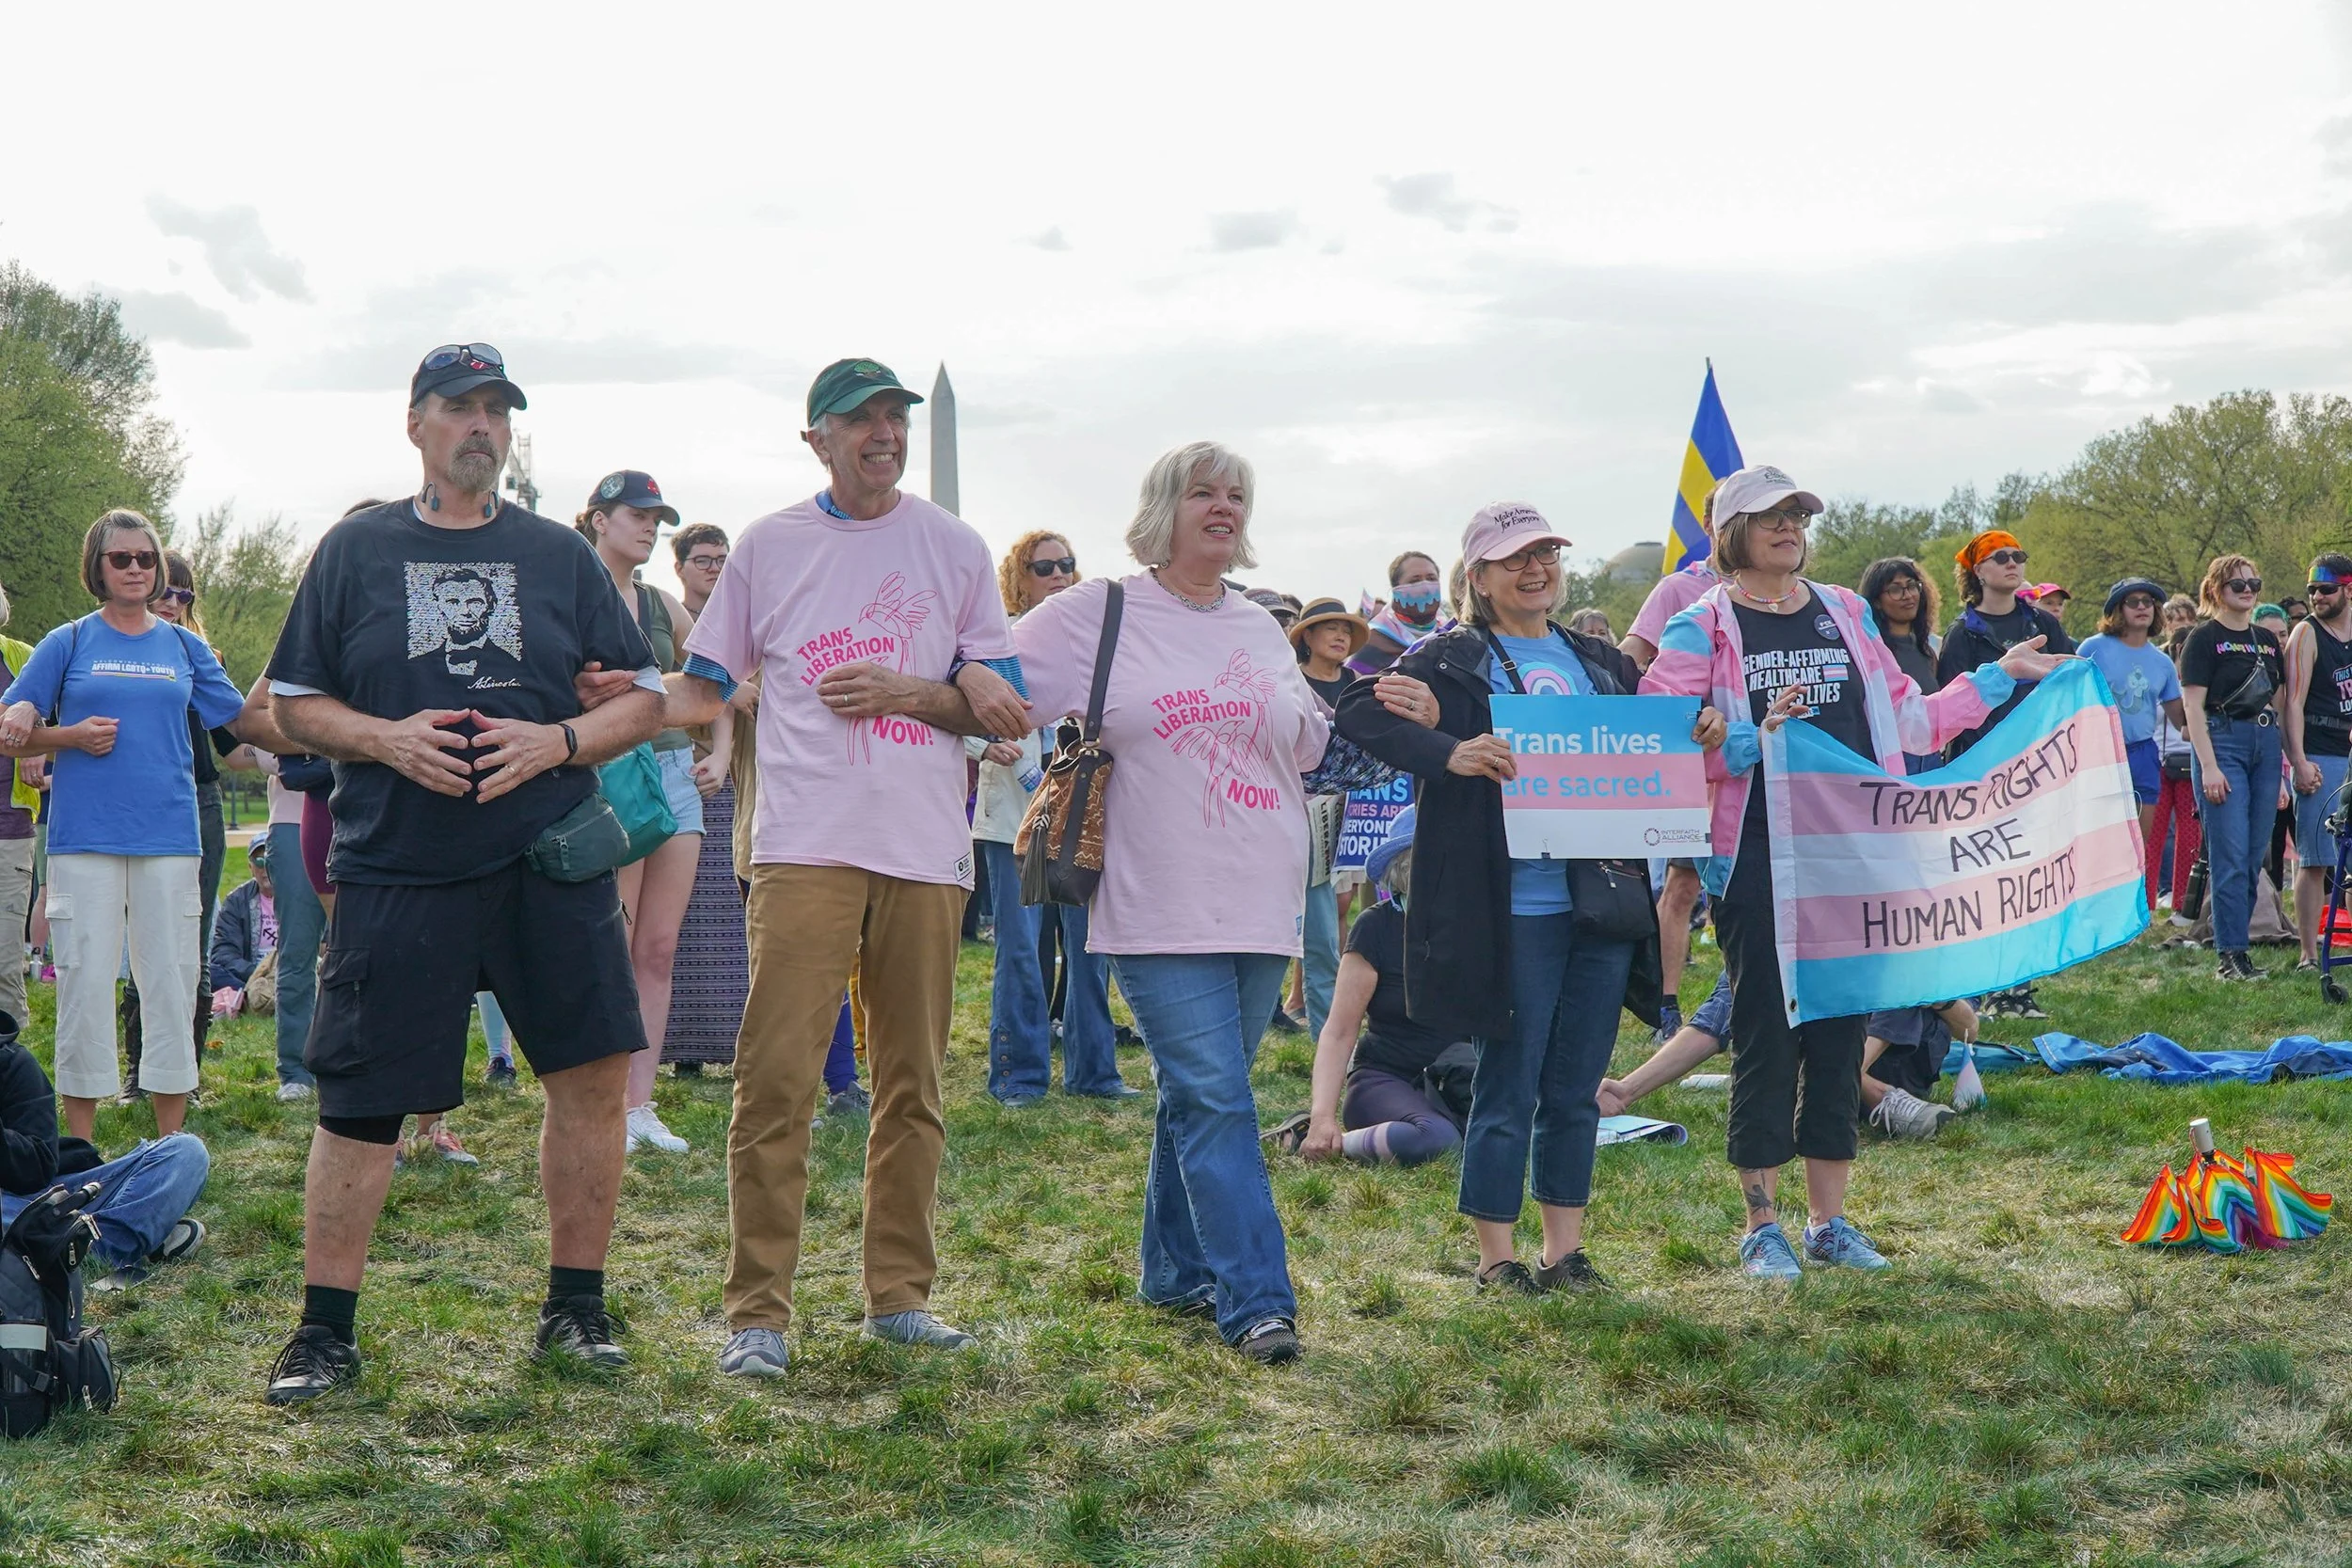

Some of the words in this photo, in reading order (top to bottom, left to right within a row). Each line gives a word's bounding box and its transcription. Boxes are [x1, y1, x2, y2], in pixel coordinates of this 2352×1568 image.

[1494, 511, 1514, 525] Make
[1501, 520, 1511, 533] for
[797, 626, 853, 660] TRANS
[91, 662, 120, 671] AFFIRM
[151, 666, 175, 676] YOUTH
[801, 637, 894, 686] LIBERATION
[1744, 647, 1850, 675] GENDER-AFFIRMING
[2335, 669, 2350, 681] THIS
[1749, 666, 1822, 691] HEALTHCARE
[1152, 689, 1210, 714] TRANS
[1806, 683, 1841, 705] LIVES
[872, 715, 934, 746] NOW!
[1152, 701, 1251, 740] LIBERATION
[1493, 727, 1582, 753] Trans
[1592, 725, 1662, 753] lives
[1504, 775, 1549, 797] are
[1558, 768, 1672, 798] sacred.
[1860, 782, 1978, 825] TRANS
[1982, 723, 2077, 815] RIGHTS
[1227, 779, 1280, 810] NOW!
[1950, 818, 2030, 872] ARE
[1863, 891, 1982, 948] HUMAN
[1997, 847, 2075, 925] RIGHTS
